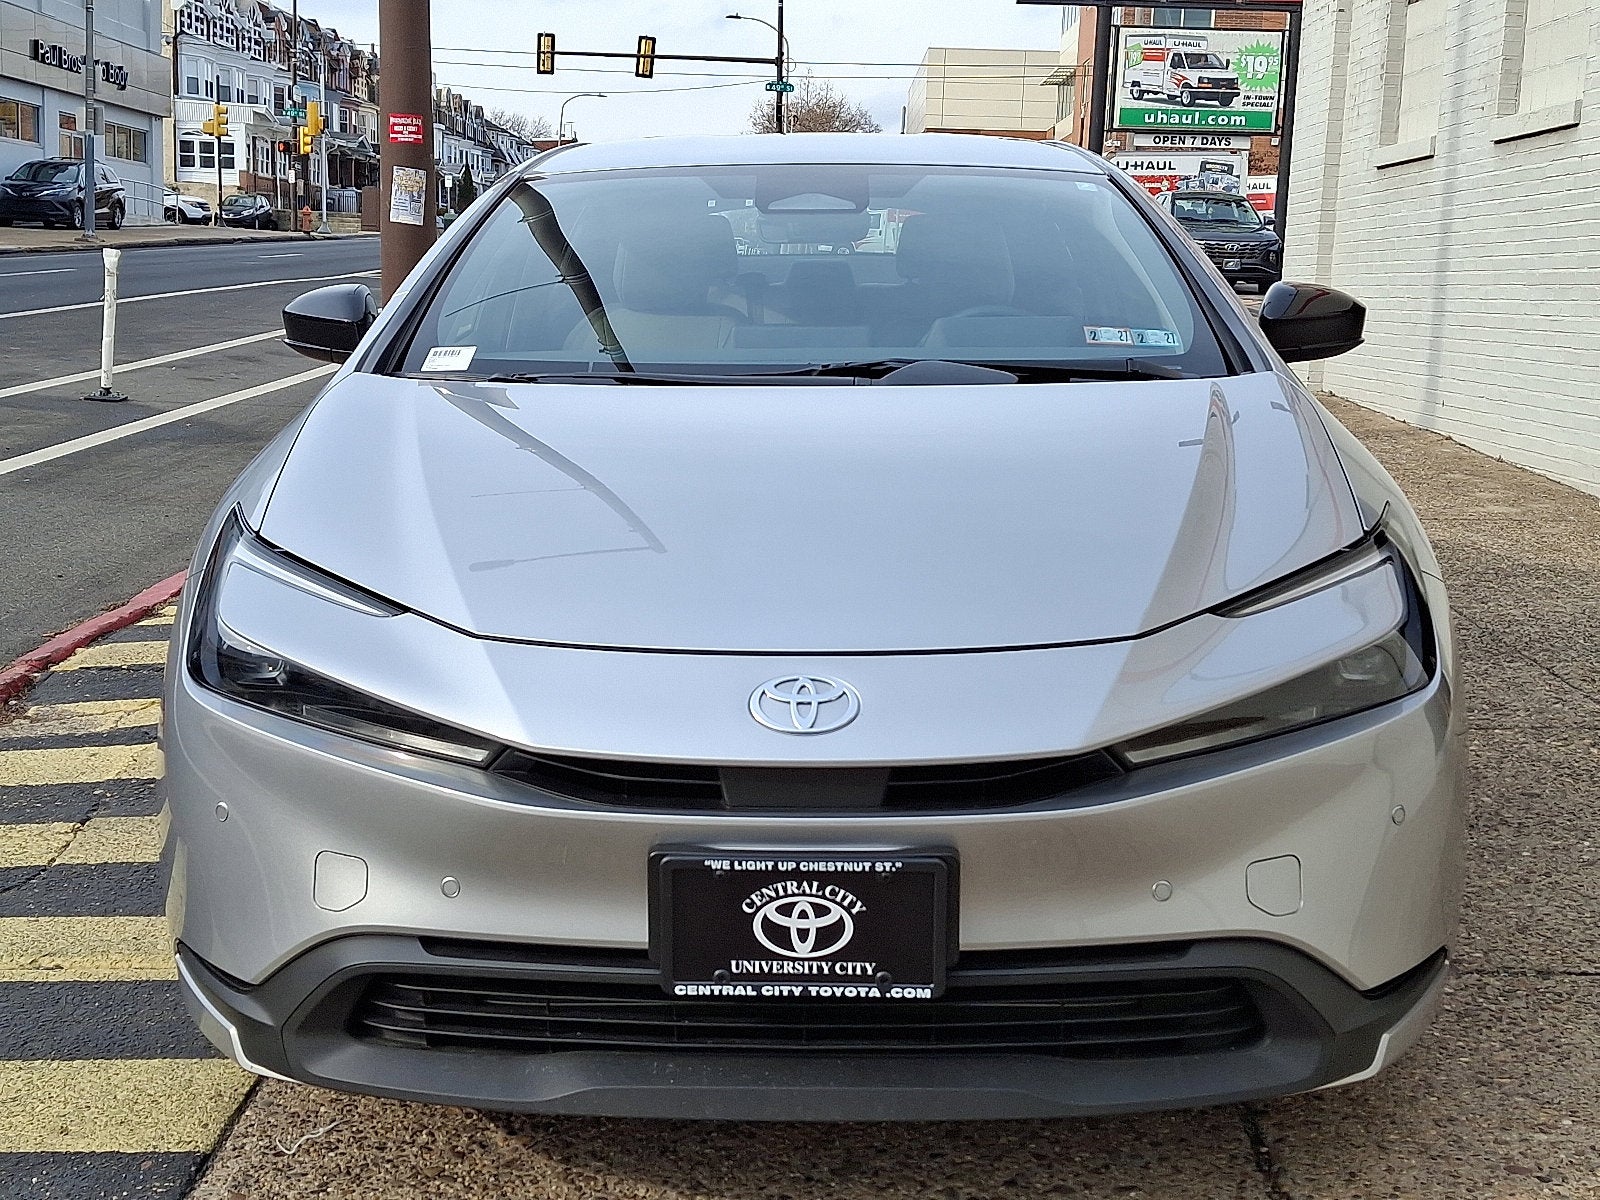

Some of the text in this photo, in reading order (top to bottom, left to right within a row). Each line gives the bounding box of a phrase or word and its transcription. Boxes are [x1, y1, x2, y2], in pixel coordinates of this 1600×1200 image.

[1173, 40, 1202, 48] U-HAUL
[37, 39, 59, 66] Paul
[61, 46, 83, 74] Bros
[108, 61, 129, 90] Body
[1144, 110, 1246, 126] uhaul.com
[1152, 135, 1232, 147] OPEN 7 DAYS
[1117, 160, 1177, 171] U-HAUL
[1089, 330, 1128, 342] 2 27
[1137, 332, 1176, 344] 2 27
[733, 860, 774, 871] LIGHT
[777, 861, 797, 871] UP
[799, 861, 873, 872] CHESTNUT
[741, 880, 868, 915] CENTRAL CITY
[730, 959, 877, 976] UNIVERSITY CITY
[673, 984, 932, 999] CENTRAL CITY TOYOTA .COM
